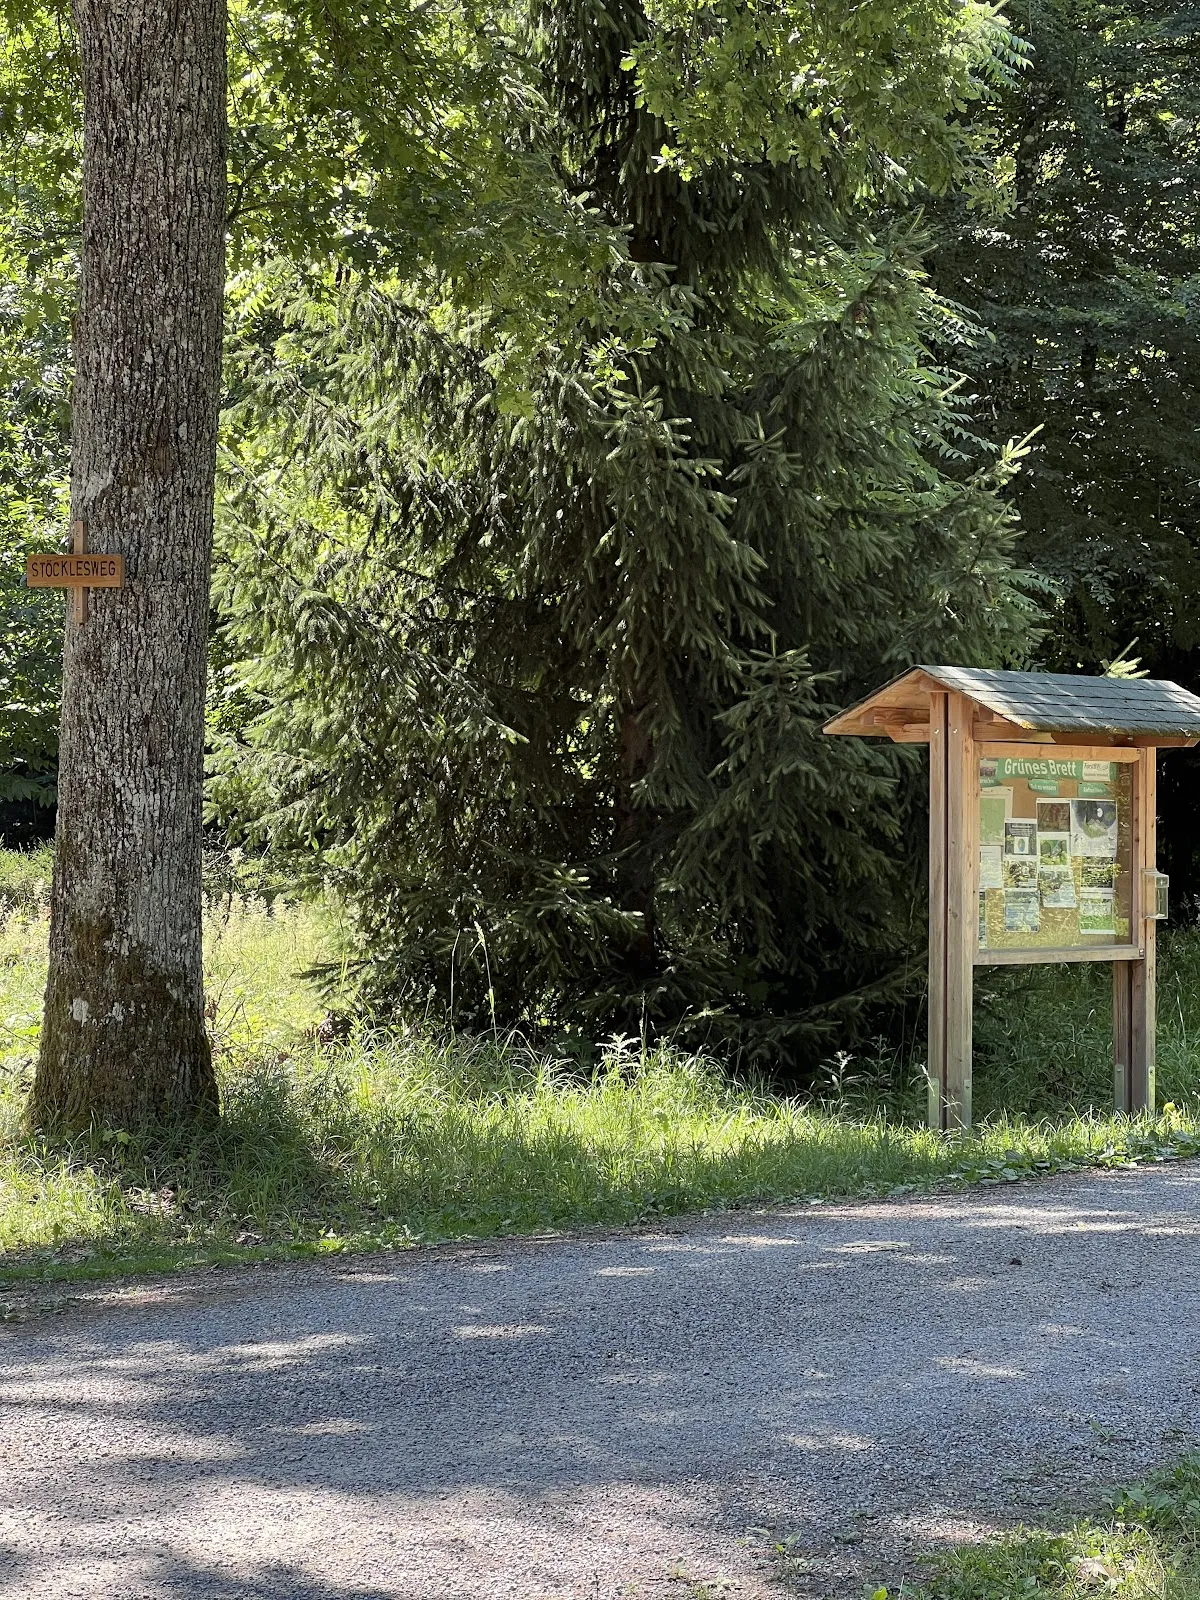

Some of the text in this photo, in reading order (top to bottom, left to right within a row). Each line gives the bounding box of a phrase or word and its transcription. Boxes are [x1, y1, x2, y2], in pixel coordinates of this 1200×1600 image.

[31, 560, 116, 577] STÖCKLESWEG
[1004, 758, 1077, 777] Grünes Brett
